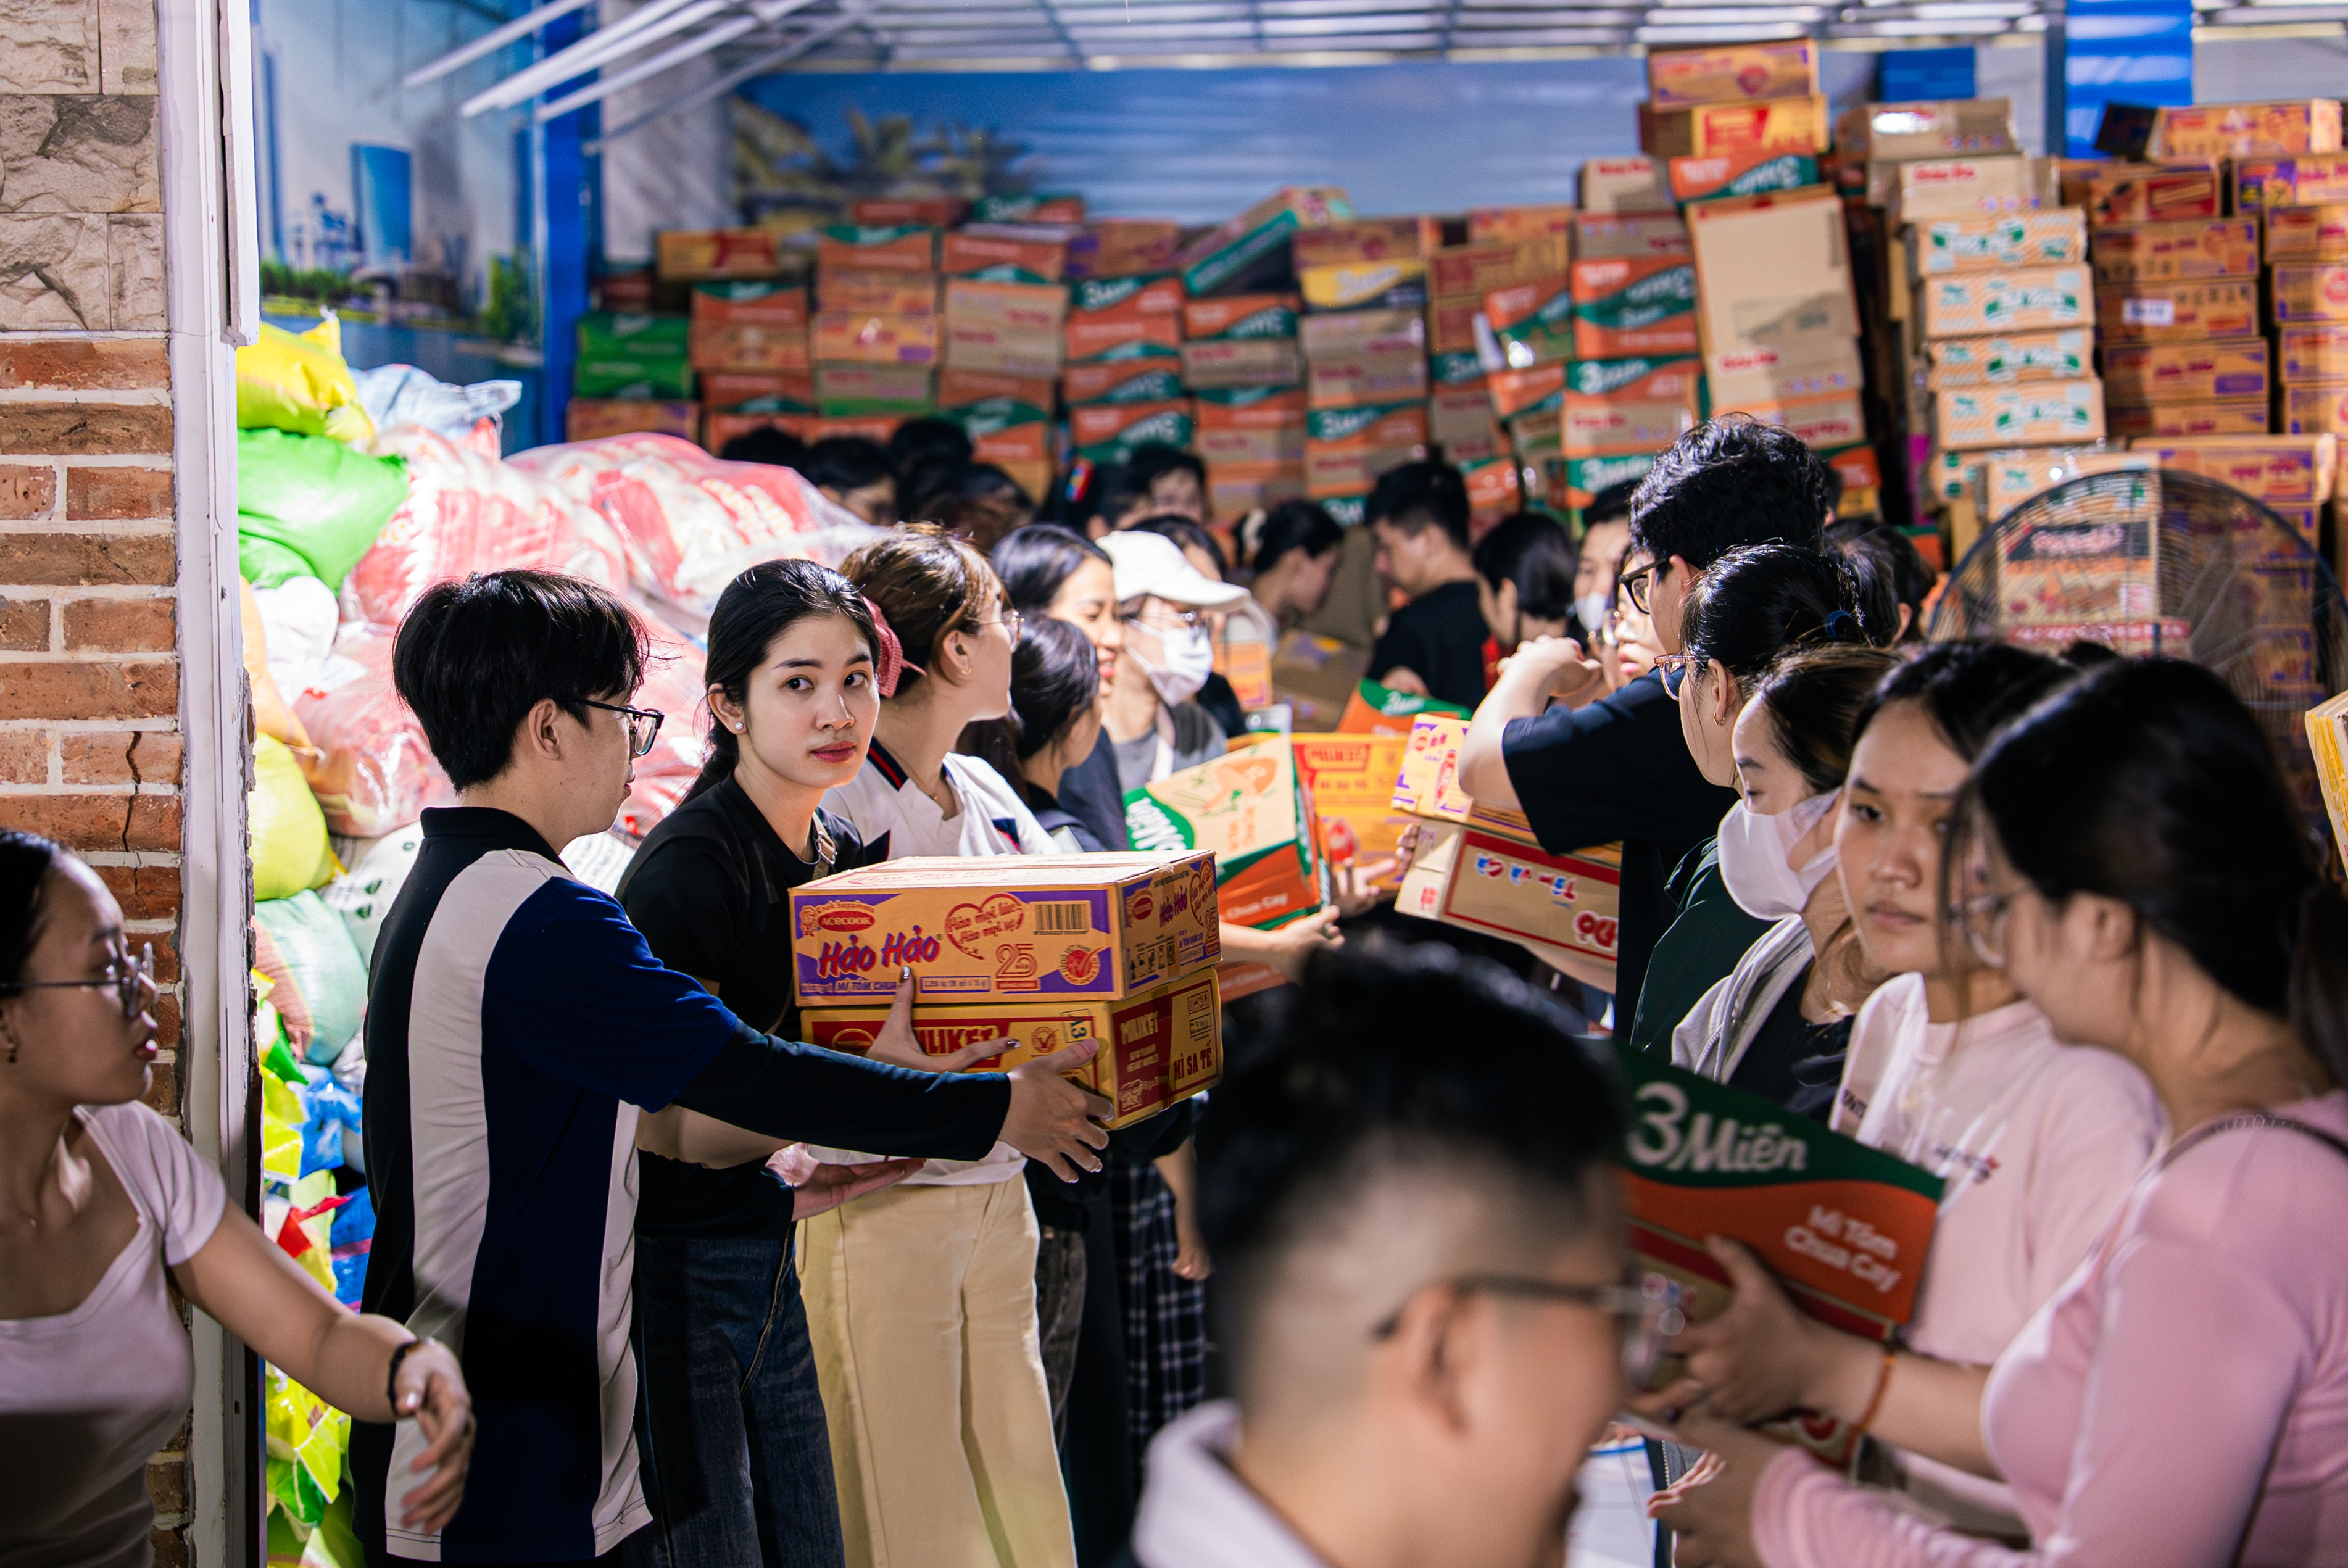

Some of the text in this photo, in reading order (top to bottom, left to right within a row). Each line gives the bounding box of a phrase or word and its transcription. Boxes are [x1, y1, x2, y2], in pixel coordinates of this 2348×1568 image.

[818, 924, 940, 978] Hảo Hảo
[995, 942, 1039, 979] 25
[1186, 1053, 1198, 1076] SA
[1626, 1081, 1688, 1166] 3
